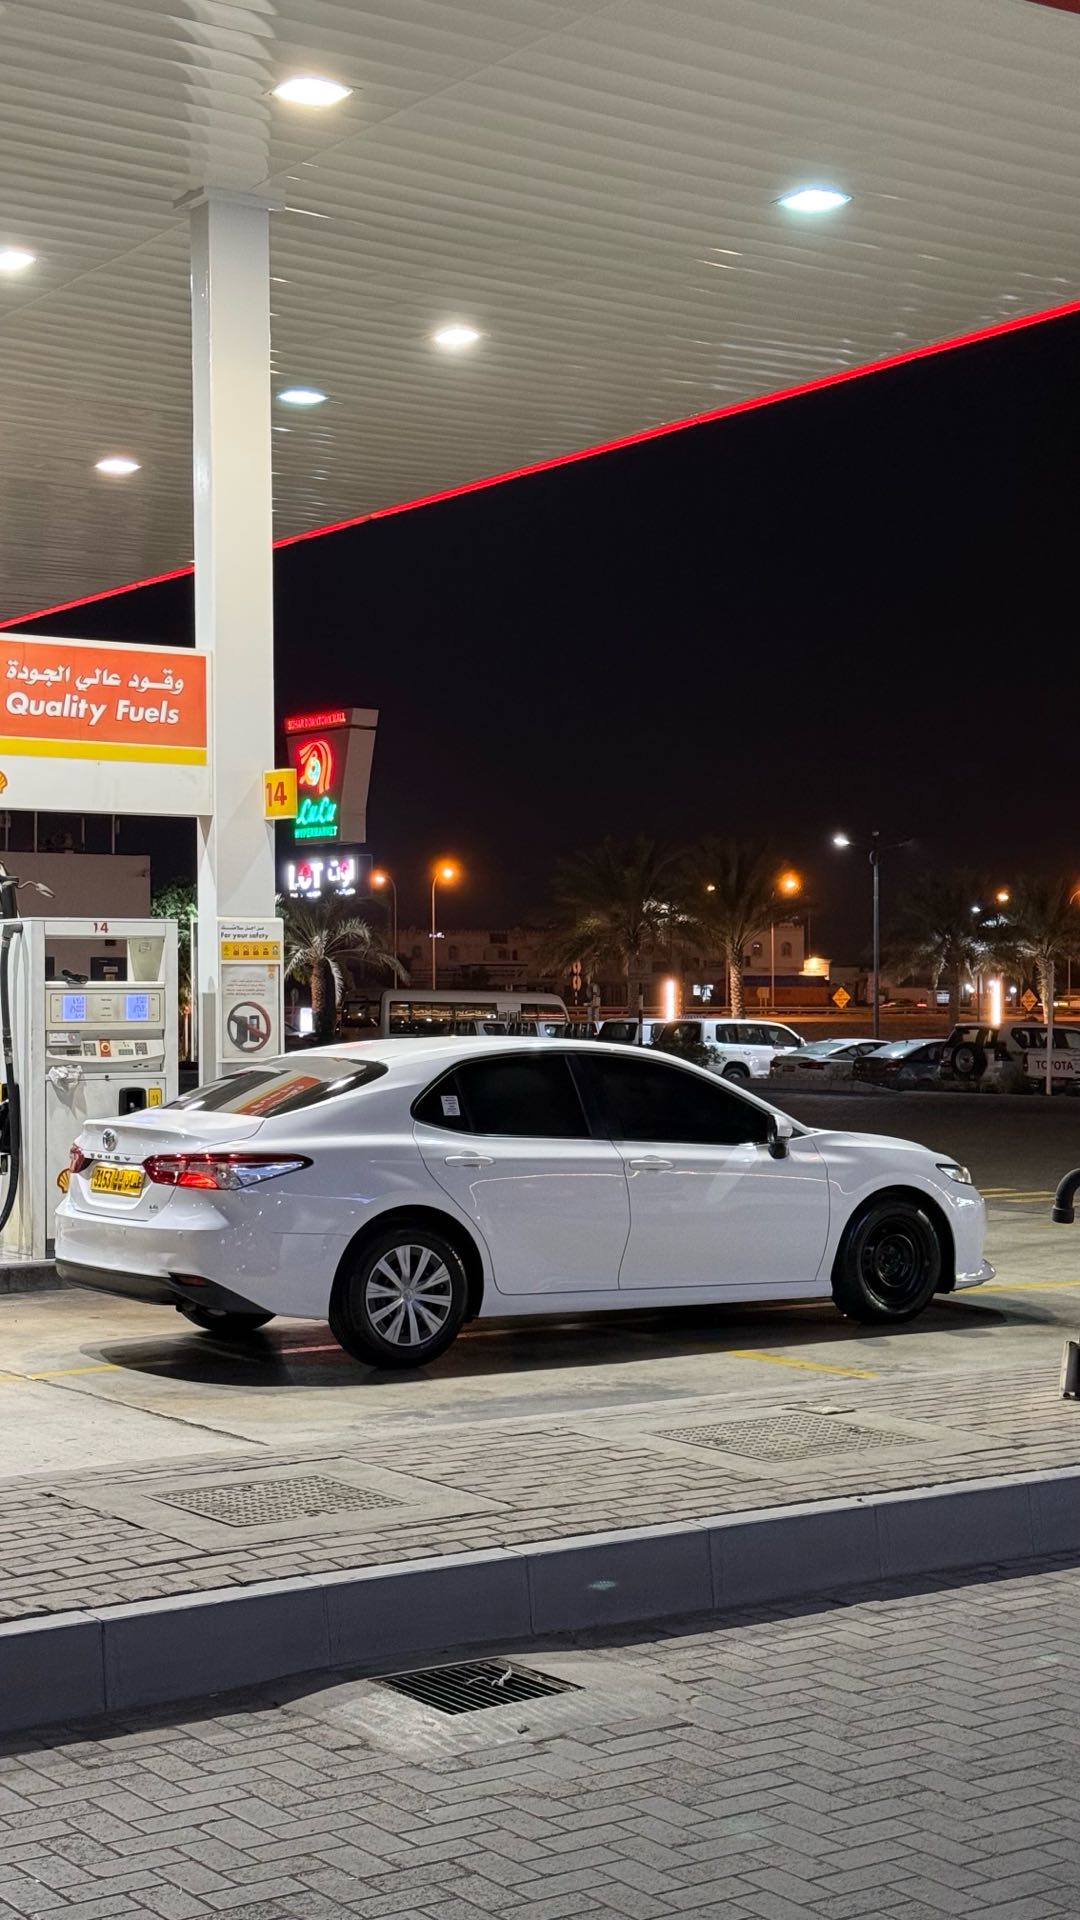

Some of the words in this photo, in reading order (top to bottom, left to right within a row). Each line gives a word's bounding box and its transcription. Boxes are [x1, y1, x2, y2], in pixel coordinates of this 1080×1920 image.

[6, 659, 70, 686] الجودة
[75, 667, 121, 691] عالي
[128, 669, 184, 695] وقود
[6, 692, 106, 726] Quality
[116, 699, 179, 724] Fuels
[266, 782, 287, 807] 14
[94, 922, 109, 933] 14
[1036, 1060, 1074, 1070] TOOTA
